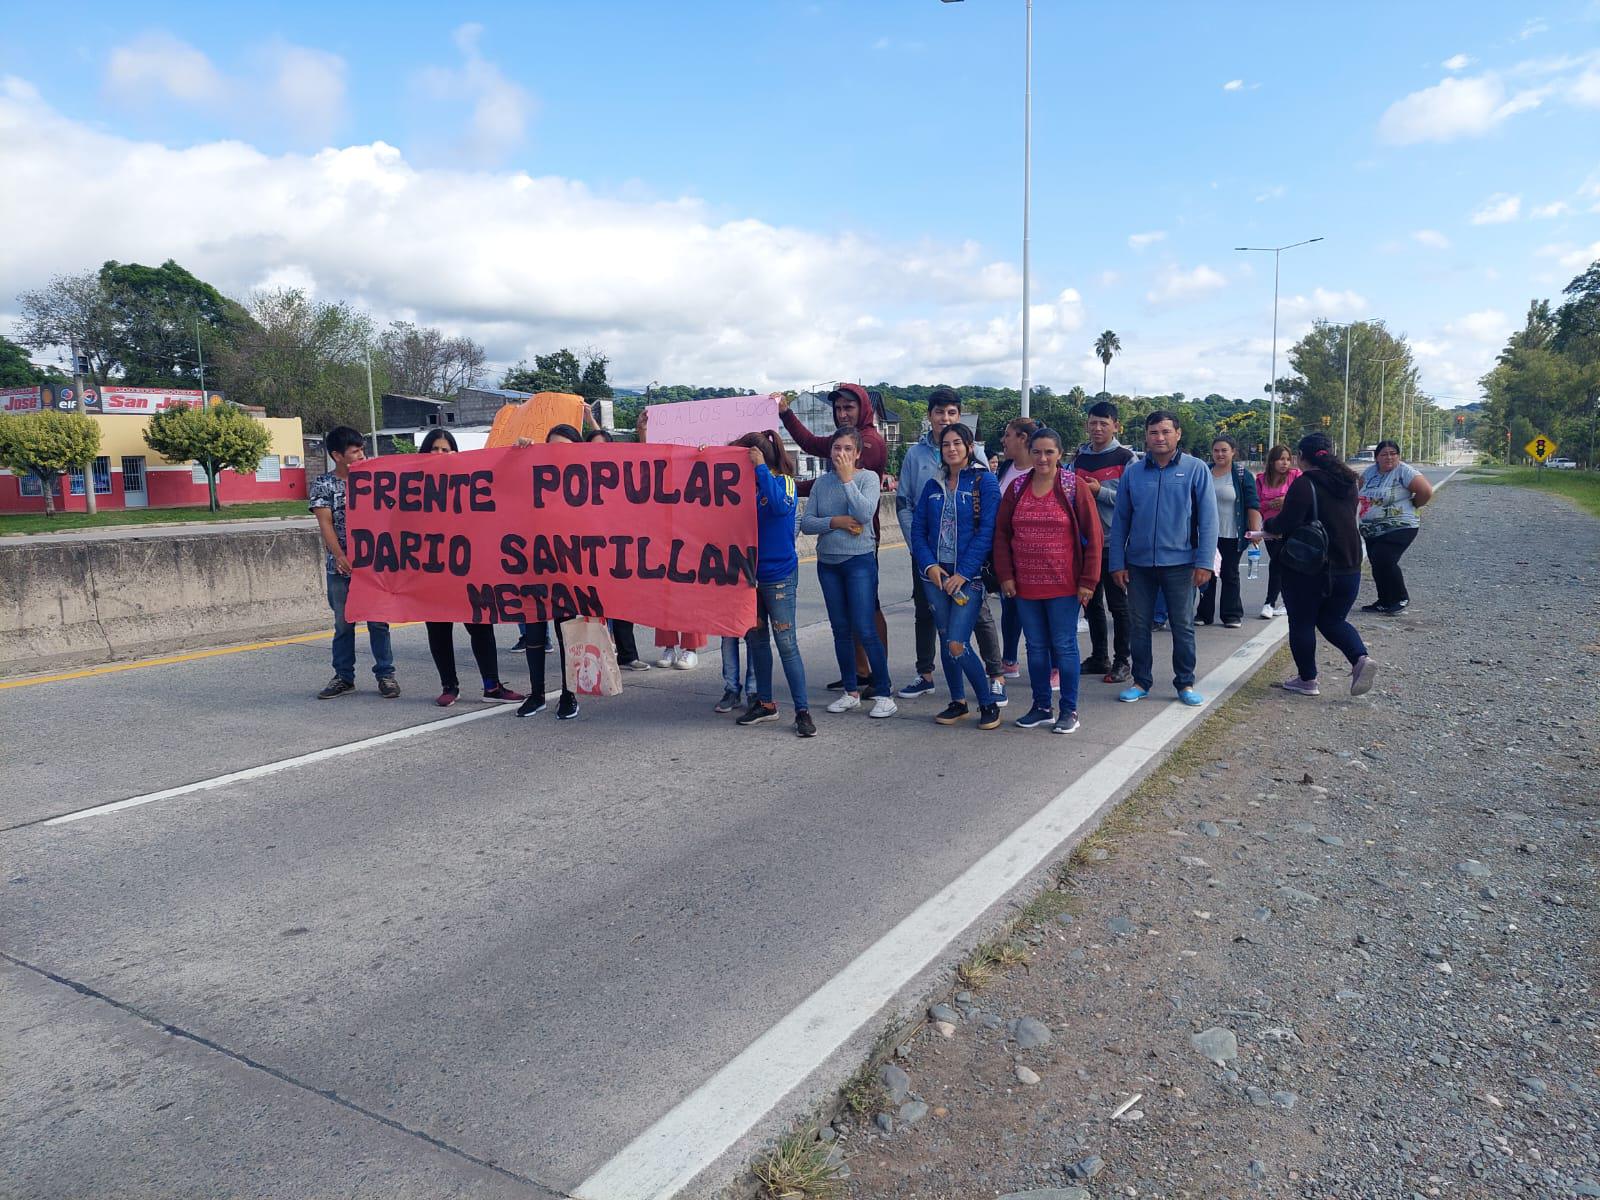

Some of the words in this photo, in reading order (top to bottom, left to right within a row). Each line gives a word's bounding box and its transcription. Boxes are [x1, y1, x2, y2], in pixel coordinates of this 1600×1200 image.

[5, 395, 36, 411] José
[59, 400, 77, 409] elf
[109, 395, 147, 409] San
[688, 405, 721, 424] LOS
[348, 470, 496, 514] FRENTE
[532, 459, 741, 509] POPULAR
[350, 528, 472, 576] DARIO
[499, 533, 758, 586] SANTILLAN
[466, 582, 604, 624] METAN
